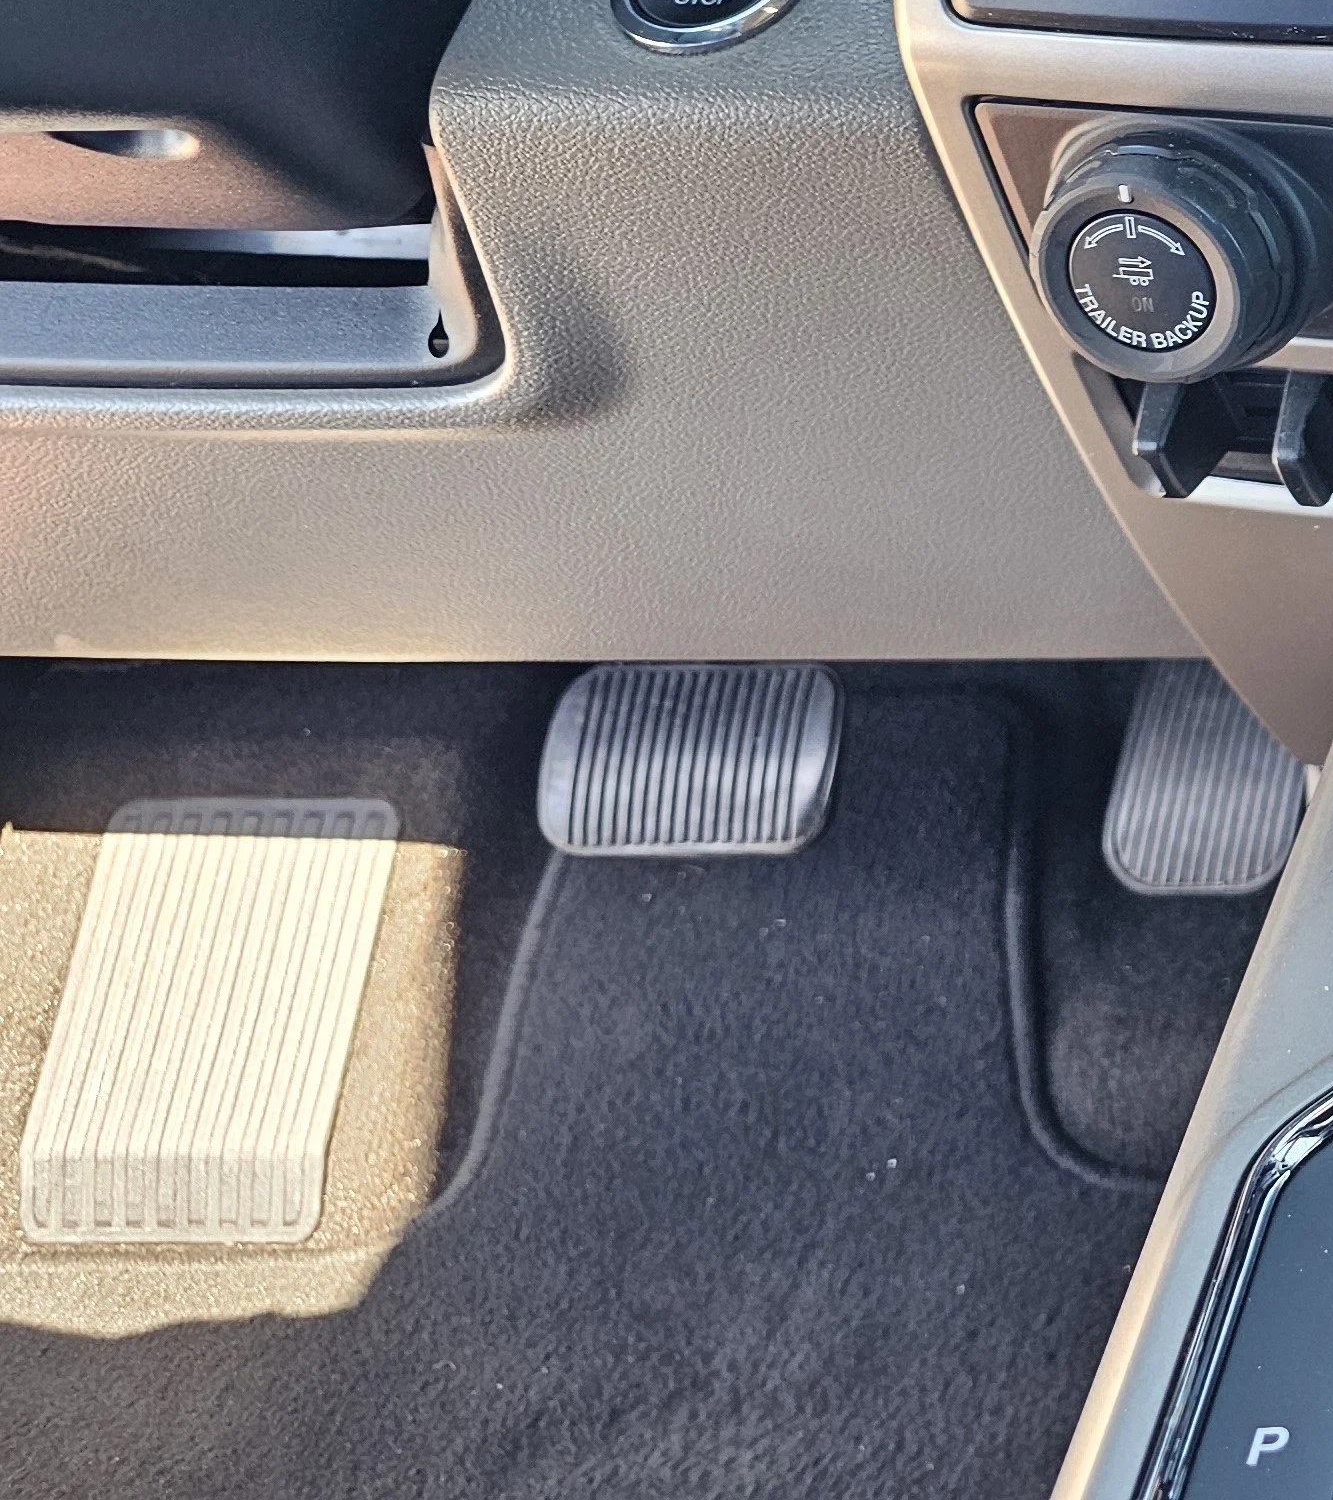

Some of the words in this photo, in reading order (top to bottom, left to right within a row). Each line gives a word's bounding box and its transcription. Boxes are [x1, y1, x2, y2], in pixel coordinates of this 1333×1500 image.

[1074, 283, 1147, 348] TRAILER
[1149, 291, 1210, 349] BACKUP
[1246, 1426, 1290, 1467] P
